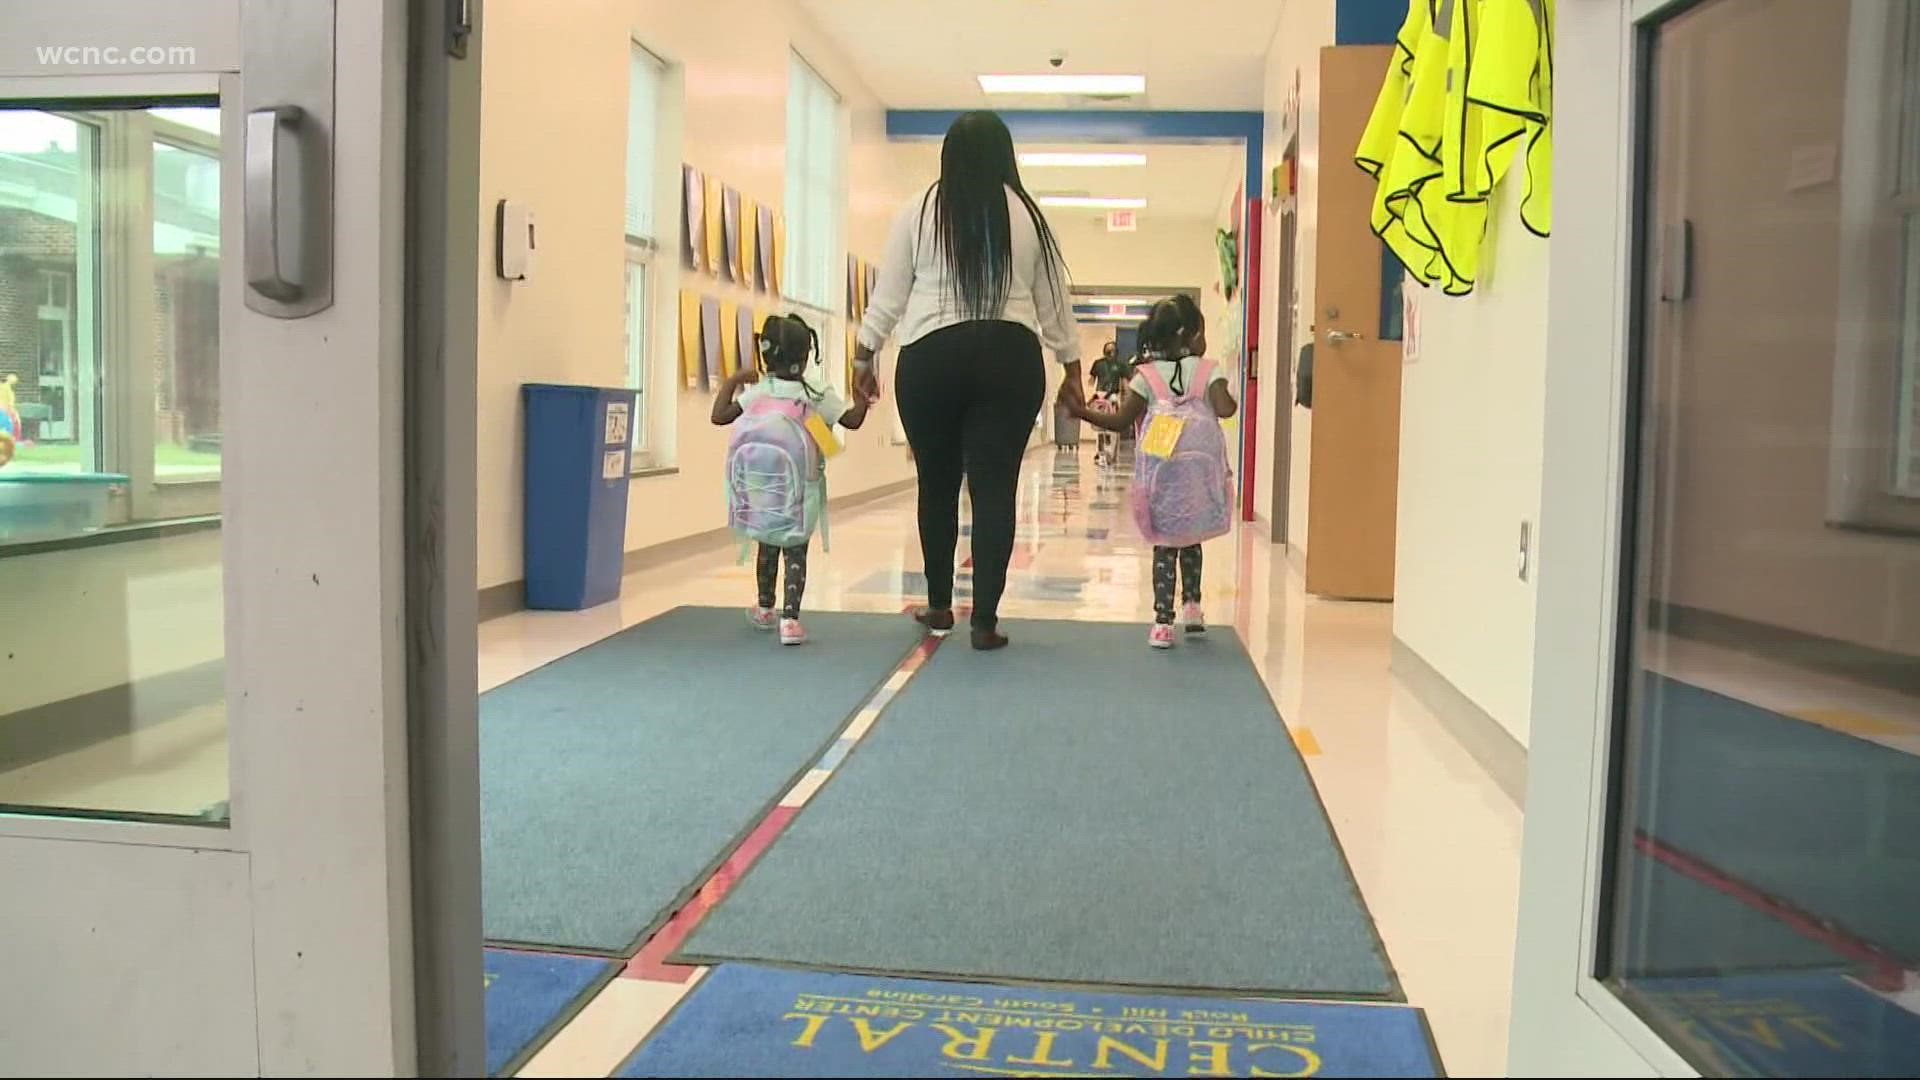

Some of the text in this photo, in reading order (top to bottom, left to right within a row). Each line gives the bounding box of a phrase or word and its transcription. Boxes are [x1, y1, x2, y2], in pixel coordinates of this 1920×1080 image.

[794, 998, 1316, 1043] CHILD DEVELOPMENT CENTER
[994, 999, 1075, 1013] South
[1181, 1010, 1249, 1023] Rock
[783, 1013, 1321, 1078] CENTRAL
